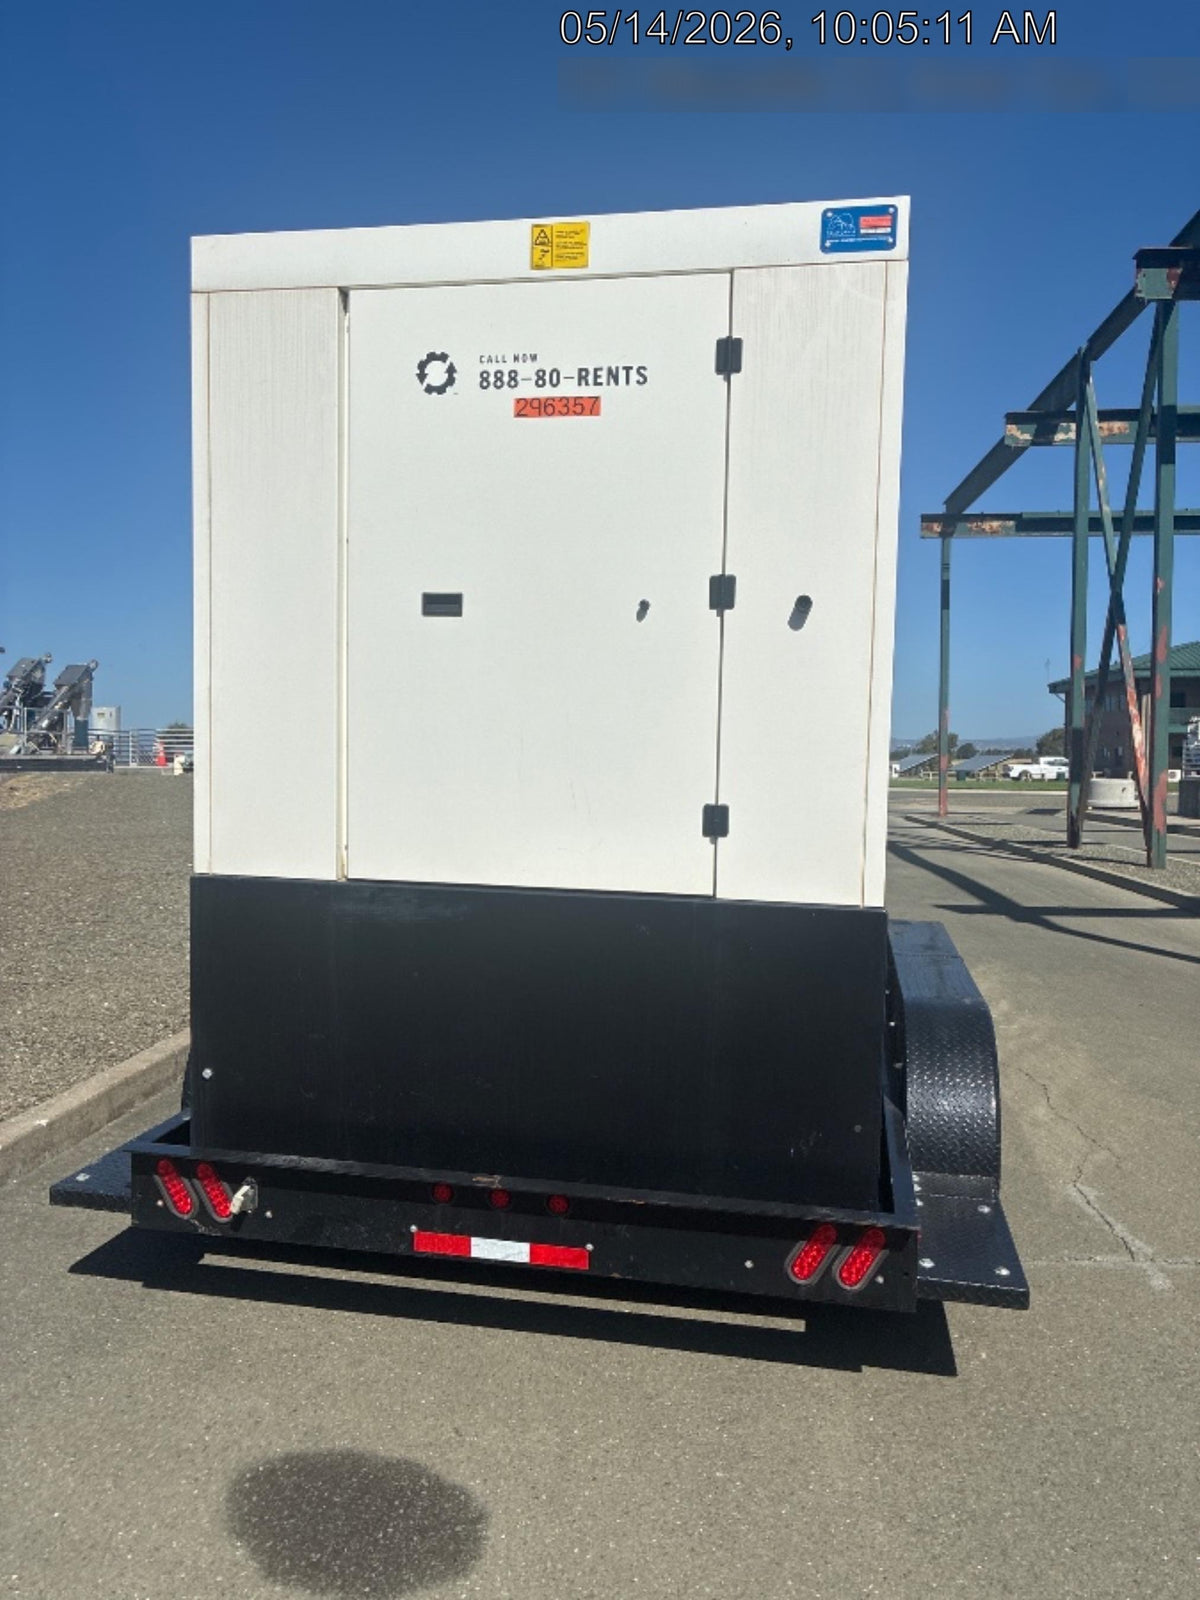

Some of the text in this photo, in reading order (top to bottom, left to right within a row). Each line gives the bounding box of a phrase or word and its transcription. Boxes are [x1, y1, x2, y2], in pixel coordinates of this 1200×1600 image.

[479, 353, 538, 364] CALL NOW
[479, 366, 648, 390] 888-80-RENTS
[516, 396, 600, 417] 296357
